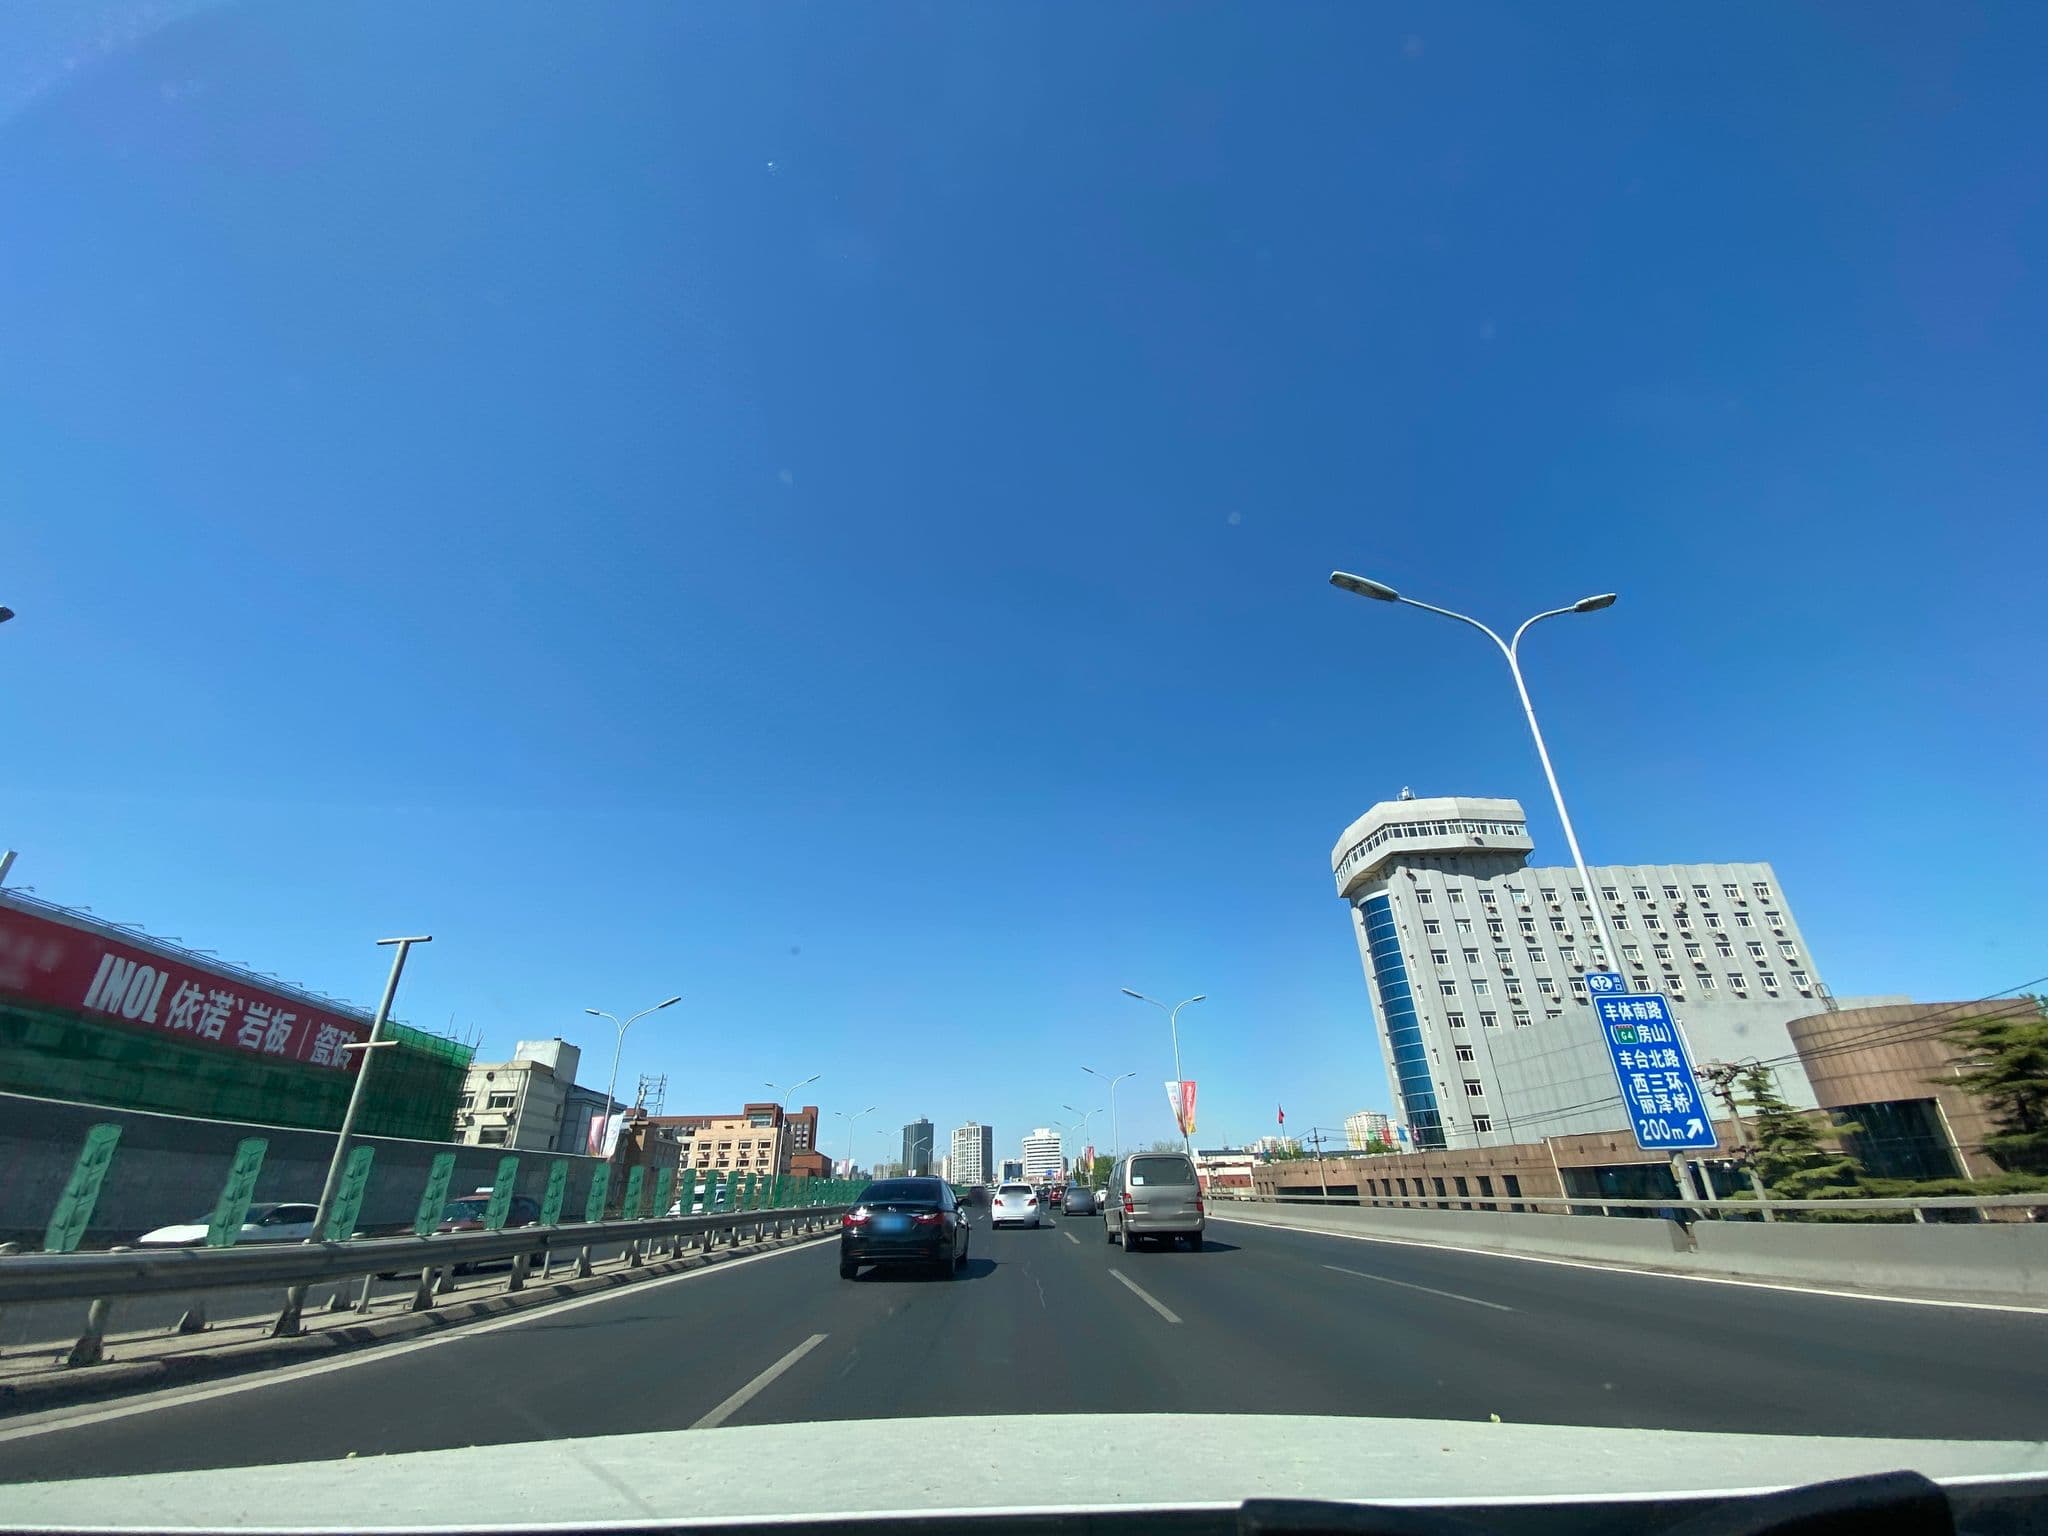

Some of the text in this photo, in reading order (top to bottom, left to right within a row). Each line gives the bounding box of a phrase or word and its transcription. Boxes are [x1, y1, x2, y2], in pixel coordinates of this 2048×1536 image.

[83, 953, 169, 1024] INOL
[1593, 978, 1609, 989] 32
[1604, 1001, 1662, 1020] 丰体南路
[1619, 1048, 1680, 1069] 丰台北路
[1639, 1119, 1685, 1140] 200m
